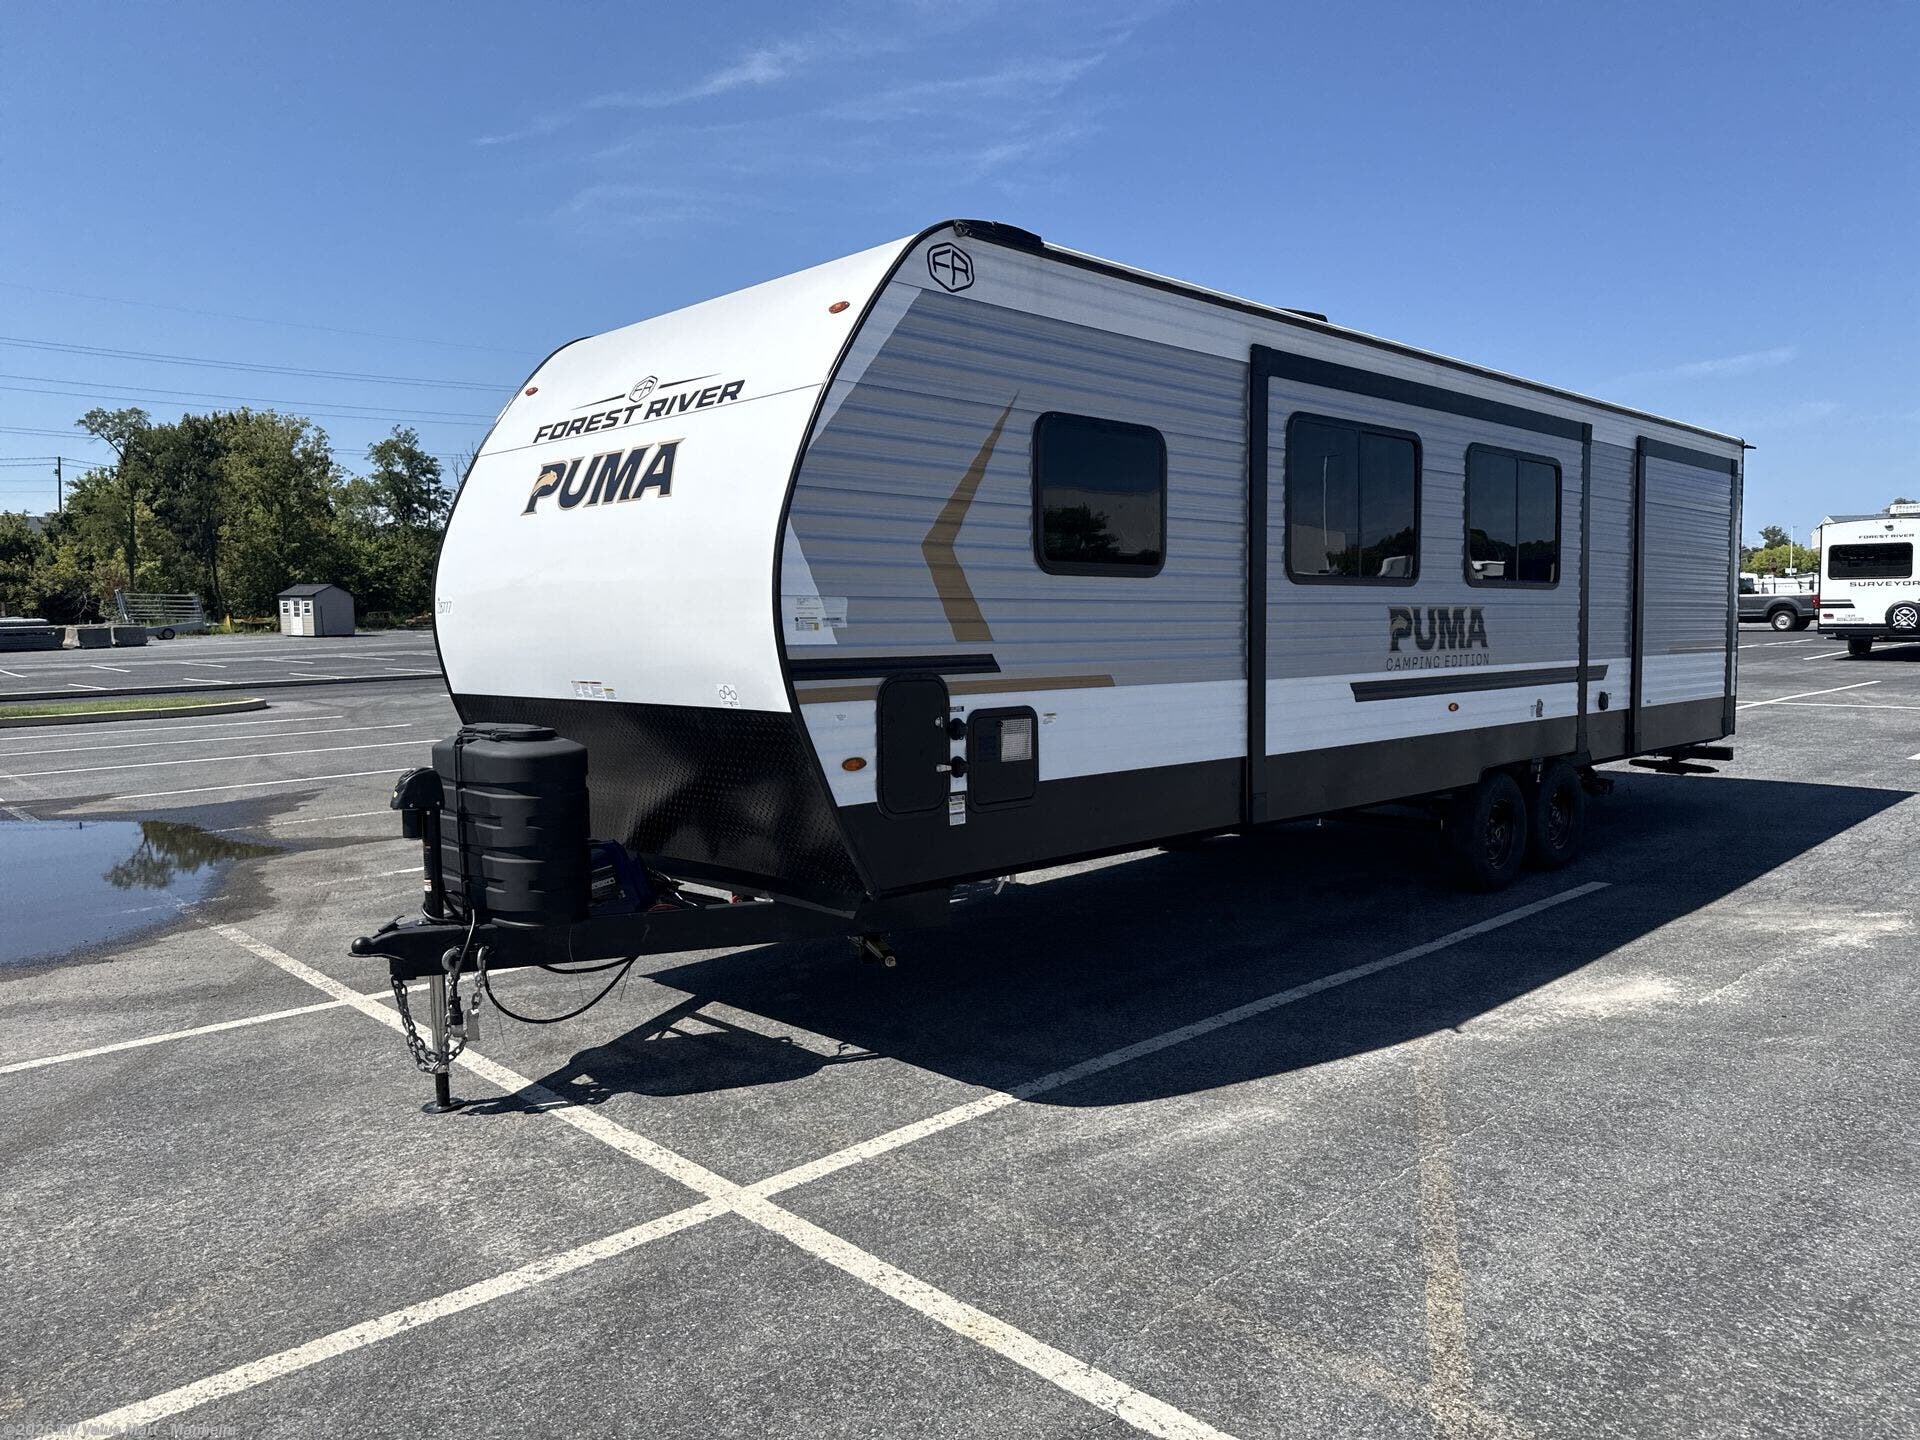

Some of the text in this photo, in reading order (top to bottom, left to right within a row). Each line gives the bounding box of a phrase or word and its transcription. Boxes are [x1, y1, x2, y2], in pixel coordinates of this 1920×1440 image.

[532, 380, 745, 443] FOREST RIVER
[521, 437, 686, 516] PUMA
[1387, 605, 1489, 653] PUMA
[1386, 653, 1490, 672] CAMPING EDITION
